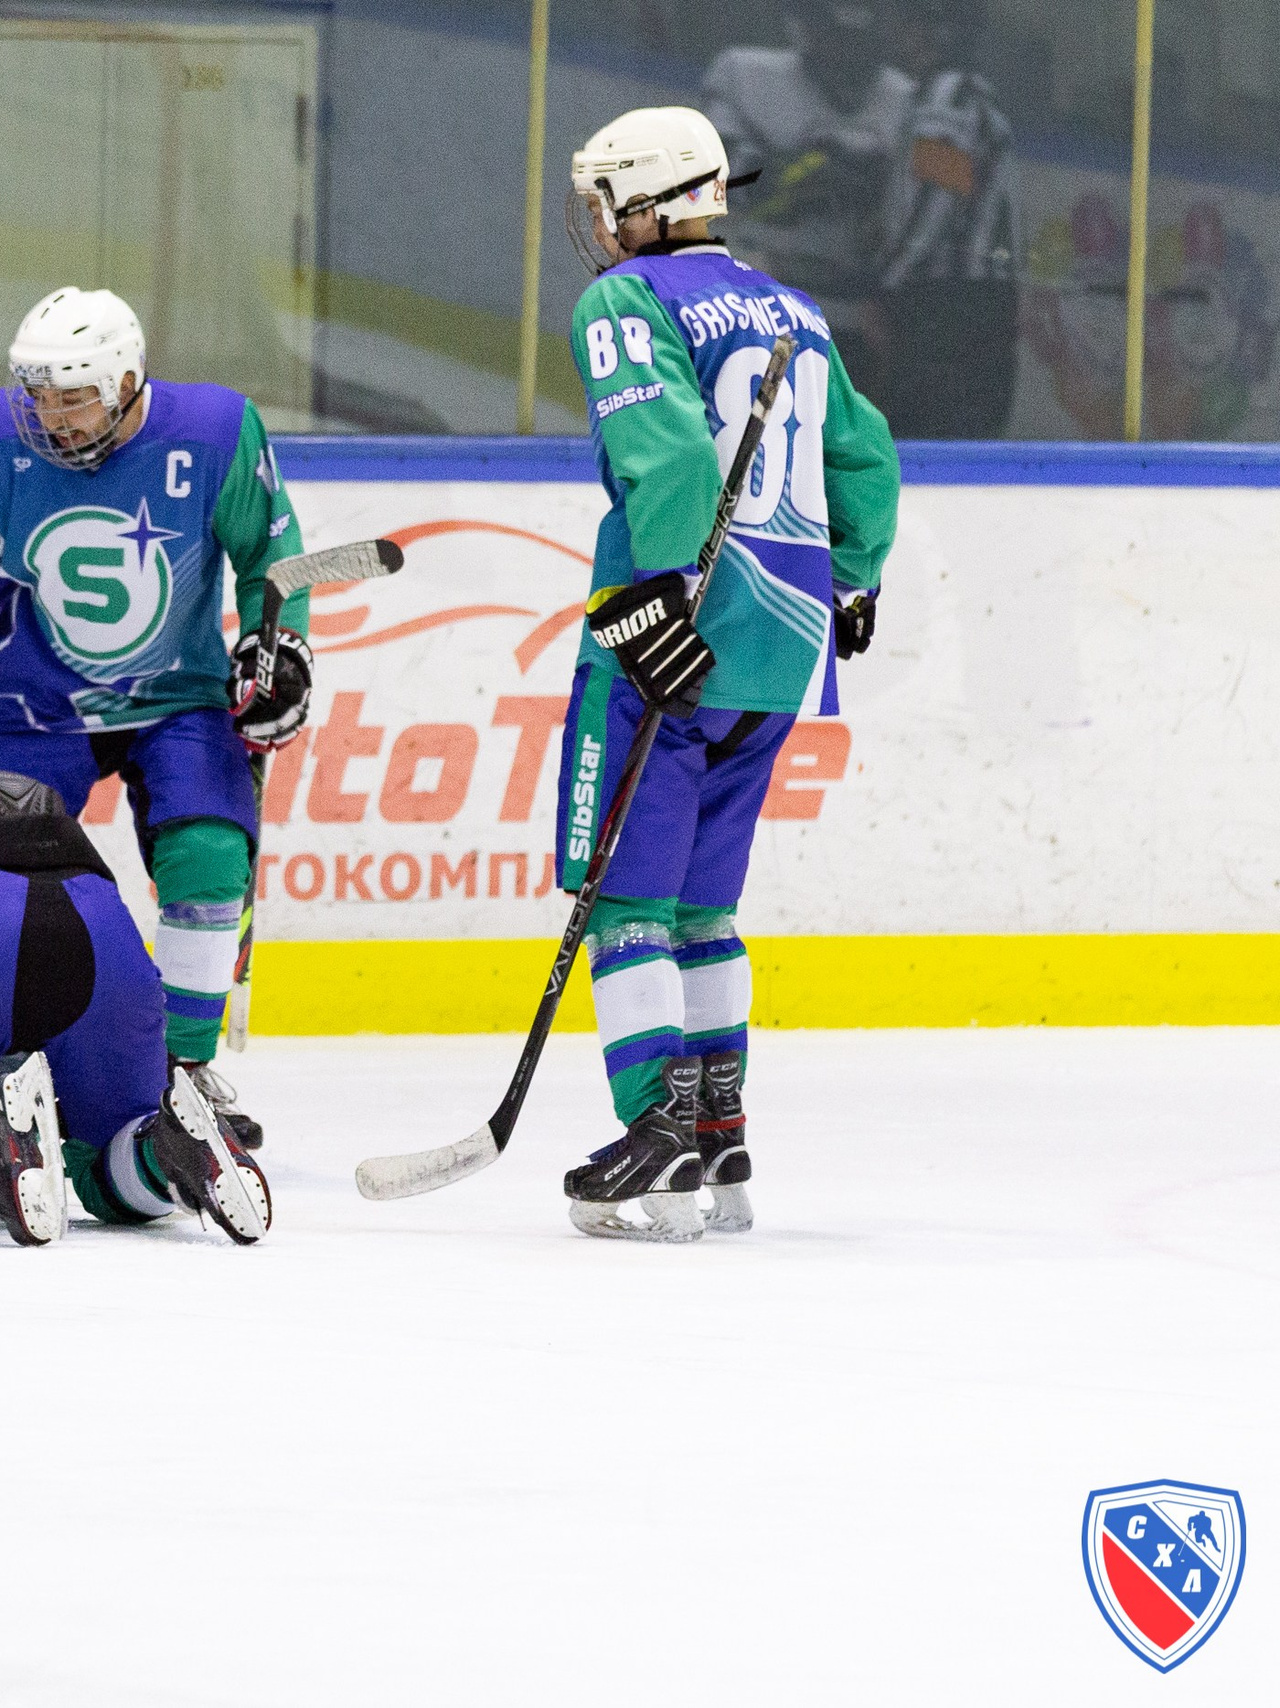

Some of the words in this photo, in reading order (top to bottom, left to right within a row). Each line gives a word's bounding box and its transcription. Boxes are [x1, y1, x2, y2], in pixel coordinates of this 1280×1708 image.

[596, 383, 665, 420] SibStar
[166, 450, 193, 498] C
[593, 598, 668, 650] RRIOR
[569, 733, 603, 863] SibStar
[604, 1156, 633, 1182] CCM
